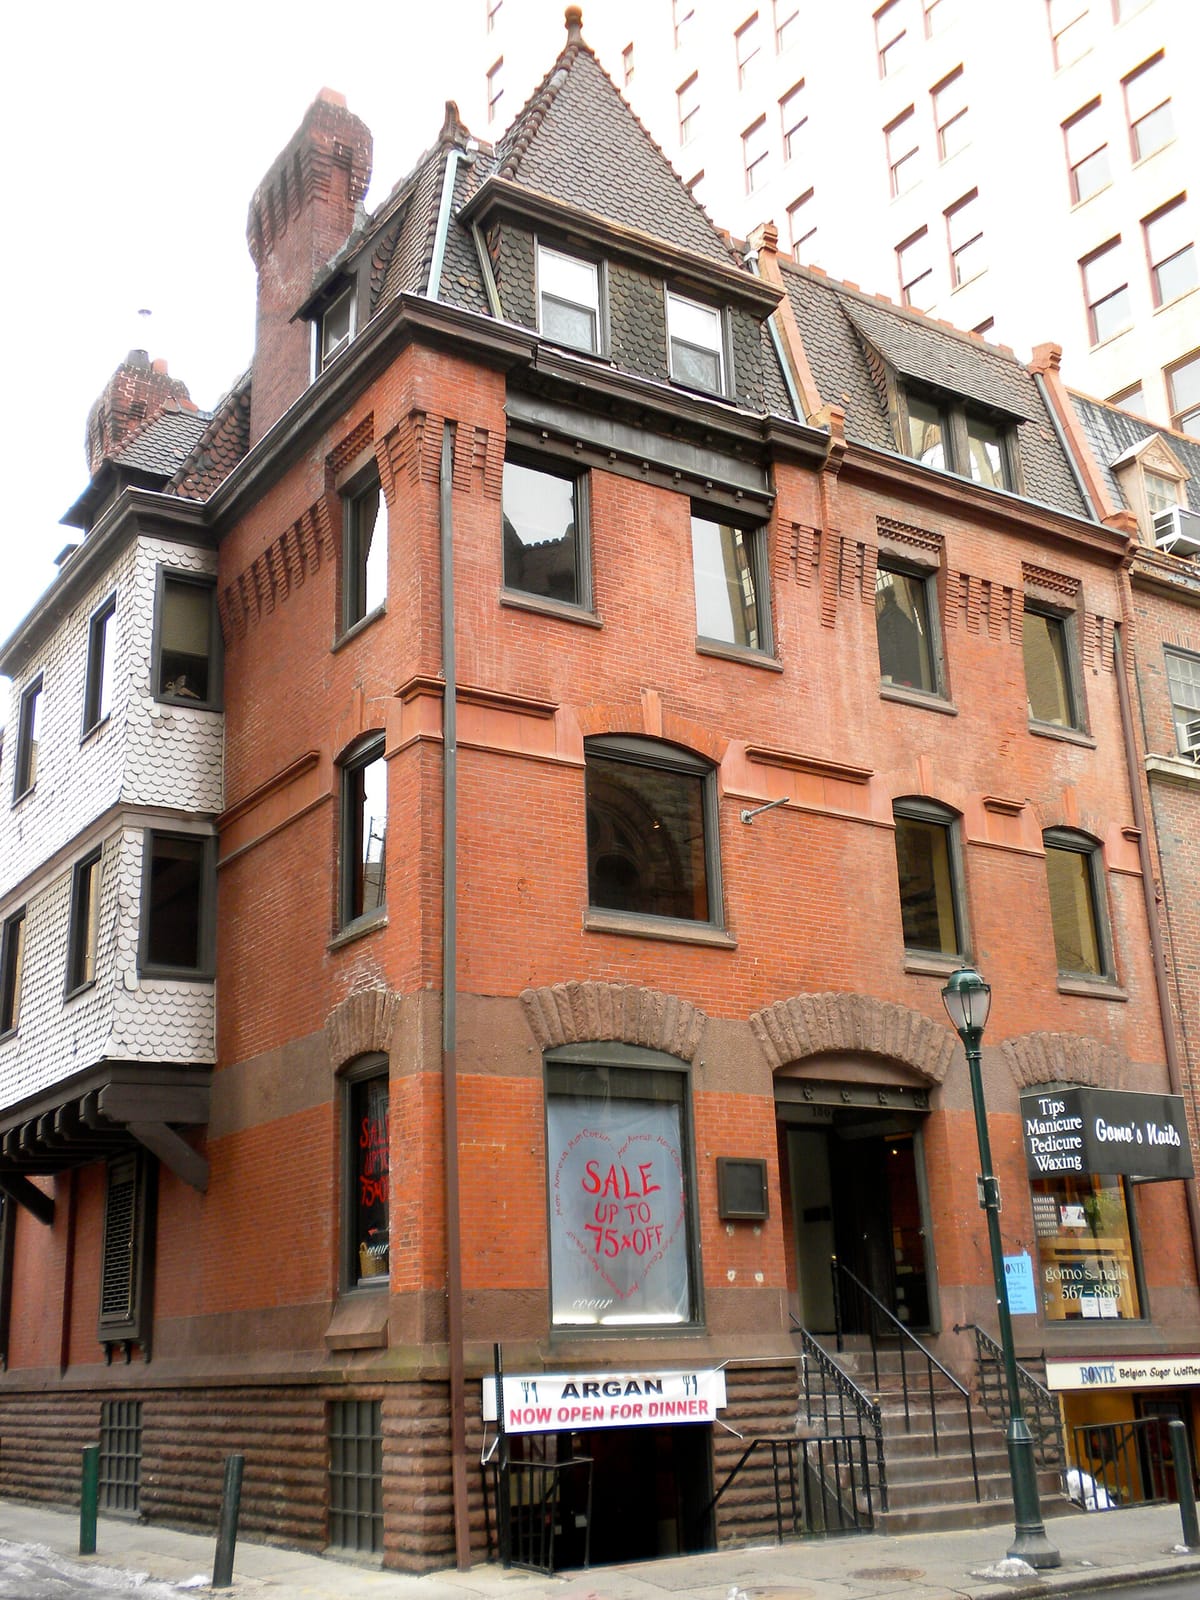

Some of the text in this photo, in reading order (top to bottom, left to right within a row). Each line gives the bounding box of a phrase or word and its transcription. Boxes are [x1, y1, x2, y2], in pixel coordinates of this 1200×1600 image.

[1038, 1098, 1065, 1116] Tips
[1026, 1116, 1083, 1136] Manicure
[1096, 1118, 1181, 1147] Gomo's Nails
[1031, 1135, 1082, 1155] Pedicure
[1034, 1153, 1082, 1172] Waxing
[581, 1160, 662, 1200] SALE
[594, 1201, 619, 1225] UP
[623, 1202, 652, 1226] TO
[1099, 1264, 1129, 1281] nails
[1119, 1368, 1147, 1380] Belgian
[1150, 1367, 1171, 1379] Sugar
[561, 1379, 663, 1399] ARGAN
[510, 1400, 709, 1426] NOW OPEN FOR DINNER
